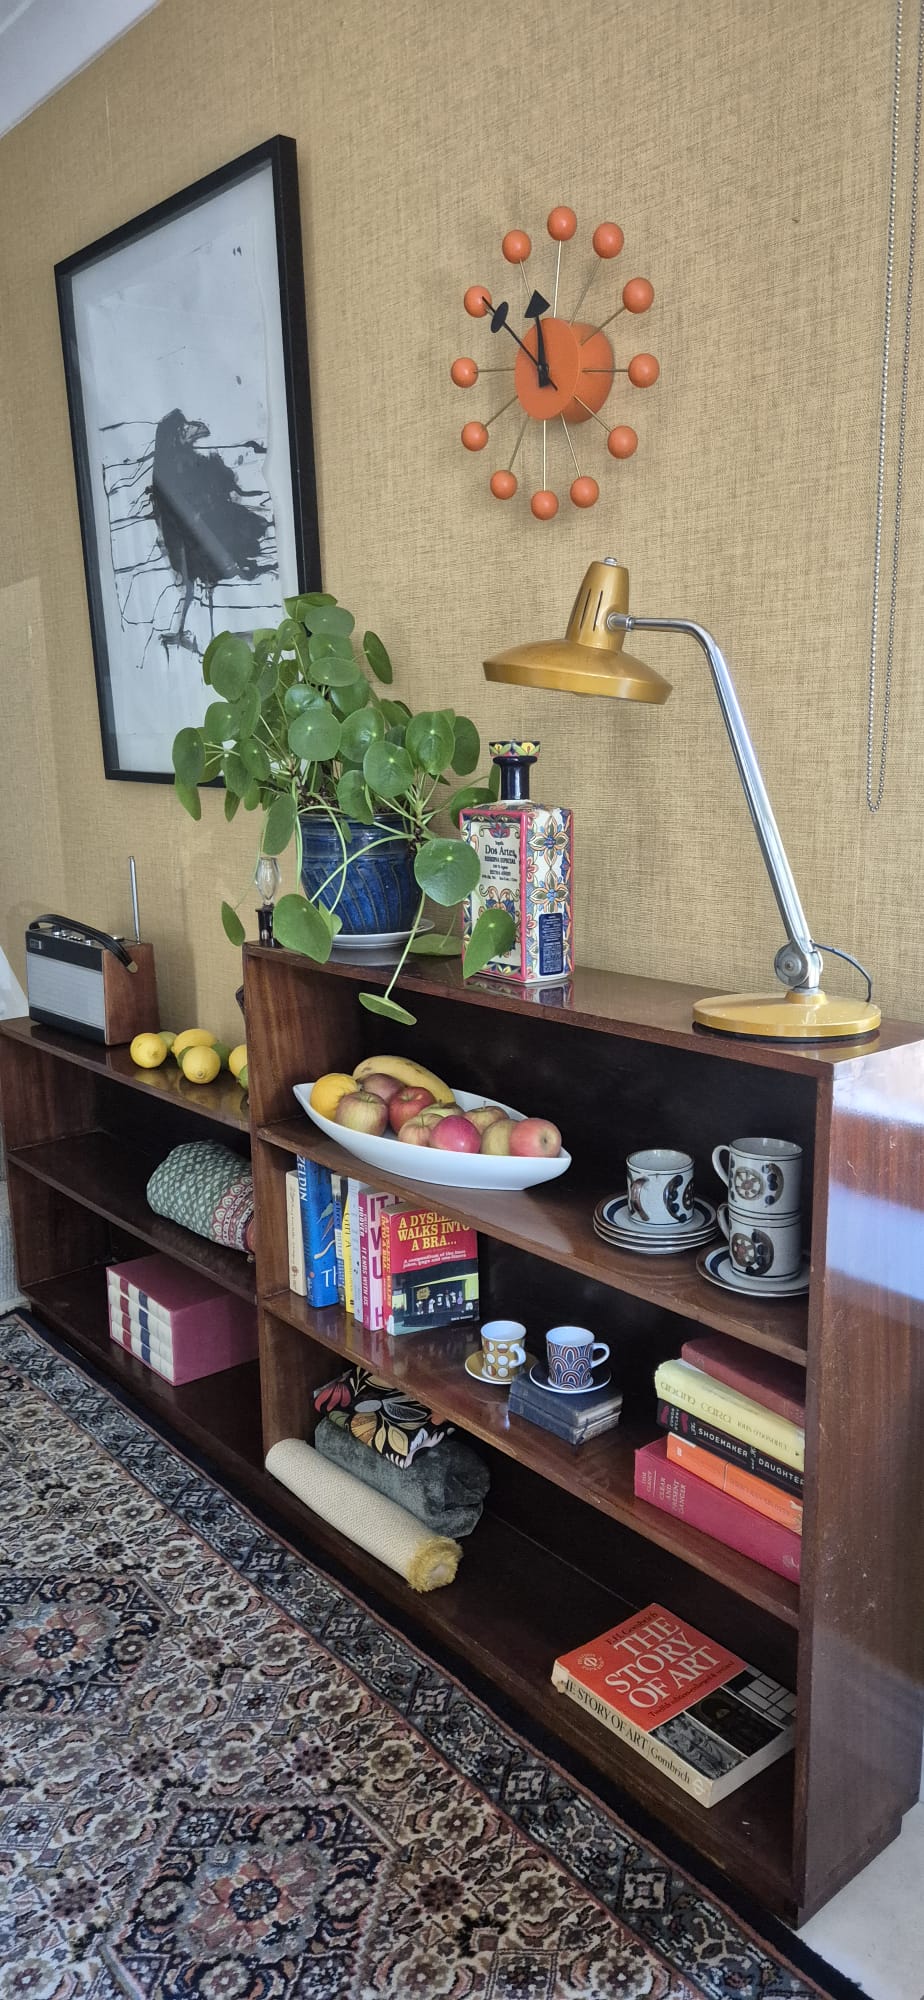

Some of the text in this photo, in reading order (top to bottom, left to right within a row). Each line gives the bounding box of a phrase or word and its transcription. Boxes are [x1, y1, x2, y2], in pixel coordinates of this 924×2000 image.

[485, 845, 517, 858] Dos Artes
[297, 1154, 307, 1201] ZELDIN
[370, 1195, 388, 1221] IT
[399, 1212, 452, 1229] A DYSL
[397, 1223, 438, 1241] WALKS
[411, 1239, 420, 1252] A
[363, 1297, 369, 1306] US
[698, 1428, 748, 1457] SHOEMAKER
[671, 1479, 681, 1511] PRESENT
[613, 1616, 681, 1657] THE
[604, 1631, 697, 1693] STORY
[628, 1645, 721, 1708] OF ART
[564, 1679, 690, 1785] HE STORY OF ART Gombrich
